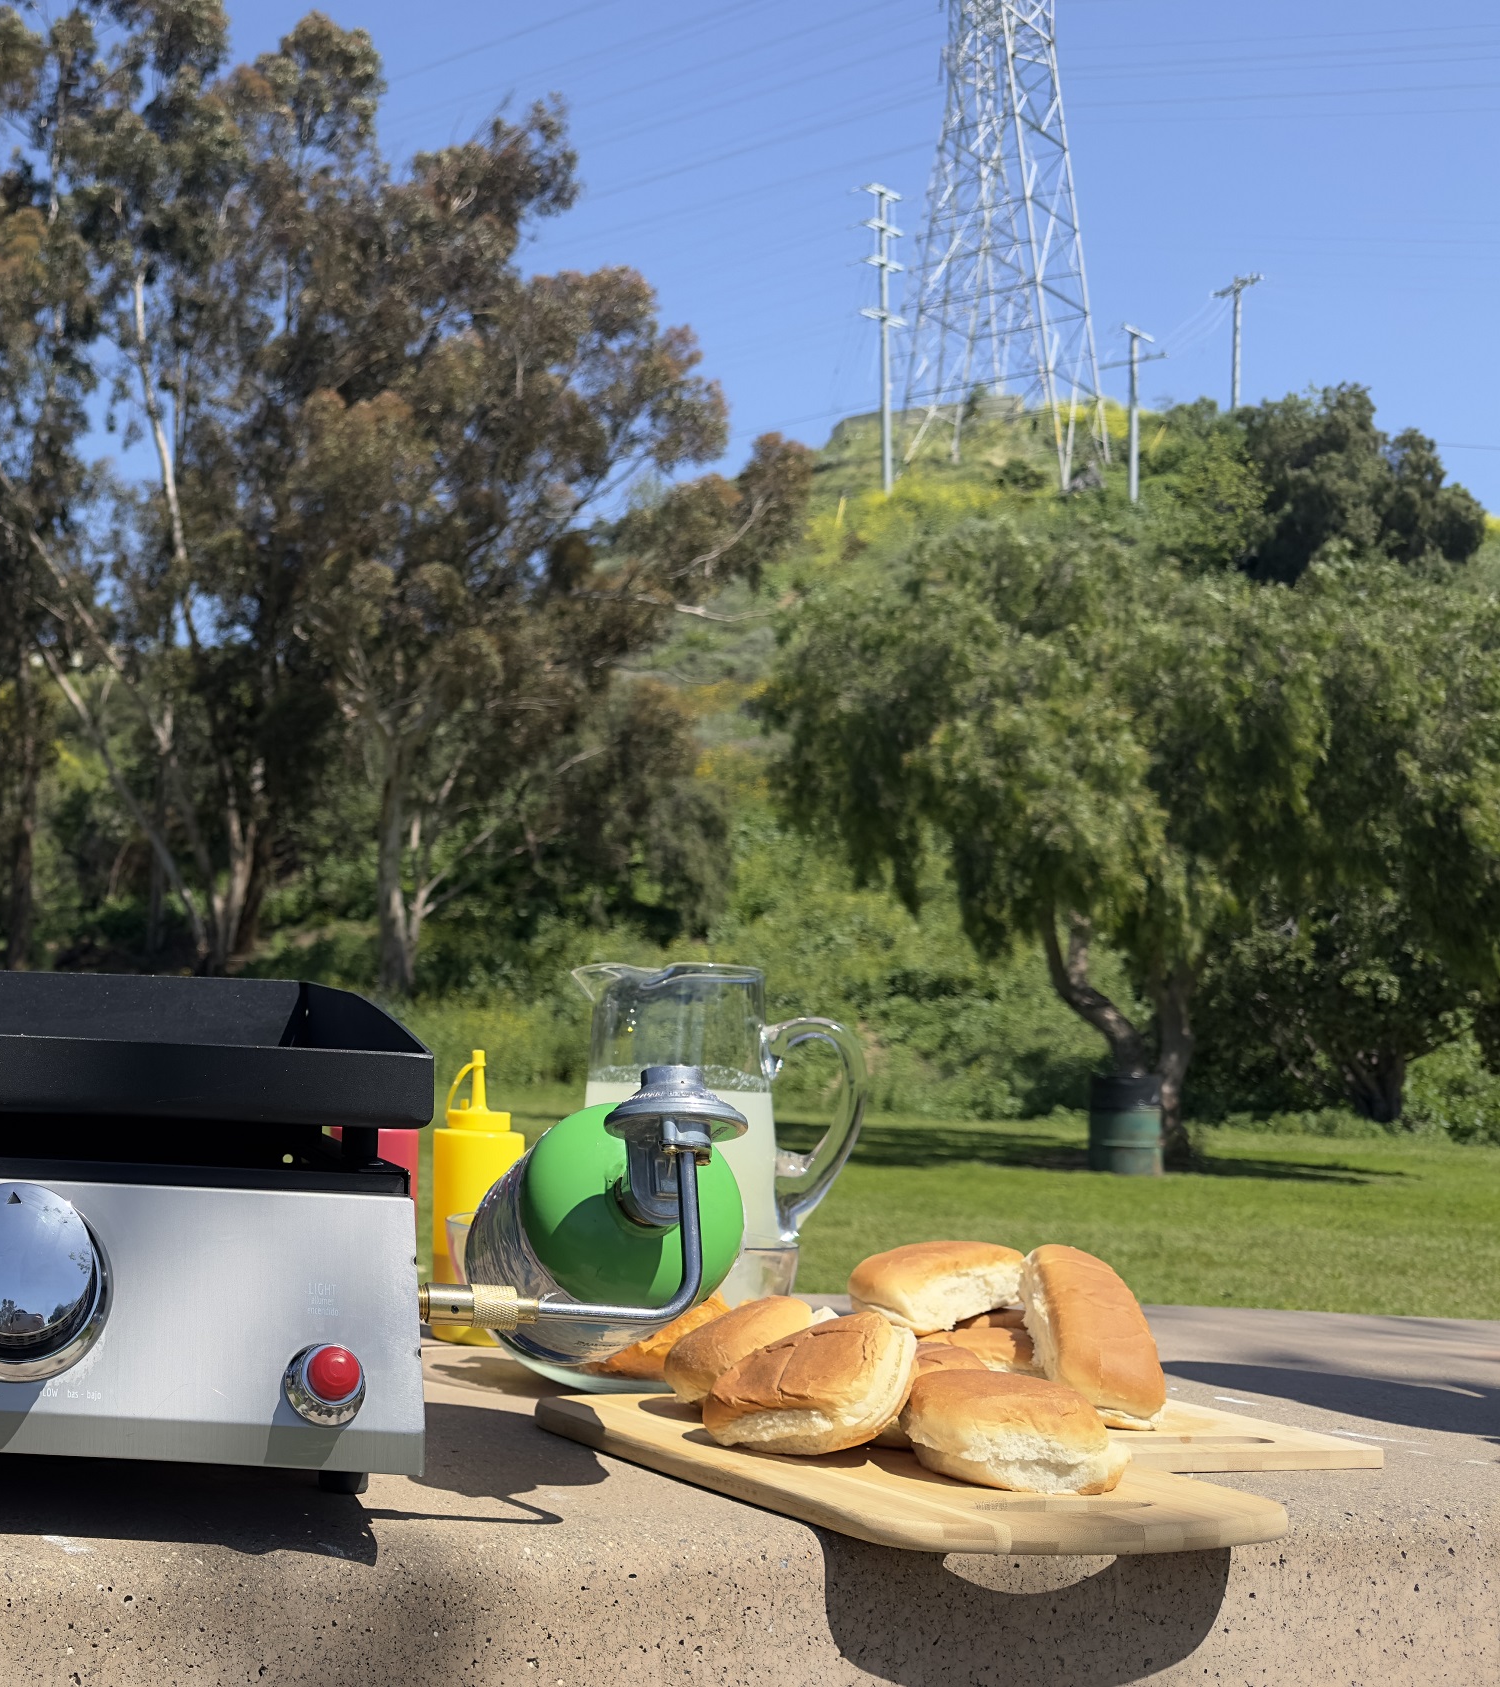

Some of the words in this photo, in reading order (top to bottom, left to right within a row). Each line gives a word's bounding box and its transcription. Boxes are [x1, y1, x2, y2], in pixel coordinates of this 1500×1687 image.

[308, 1282, 337, 1296] LIGHT
[42, 1388, 58, 1398] LOW
[67, 1389, 79, 1399] bas
[87, 1390, 102, 1401] bajo
